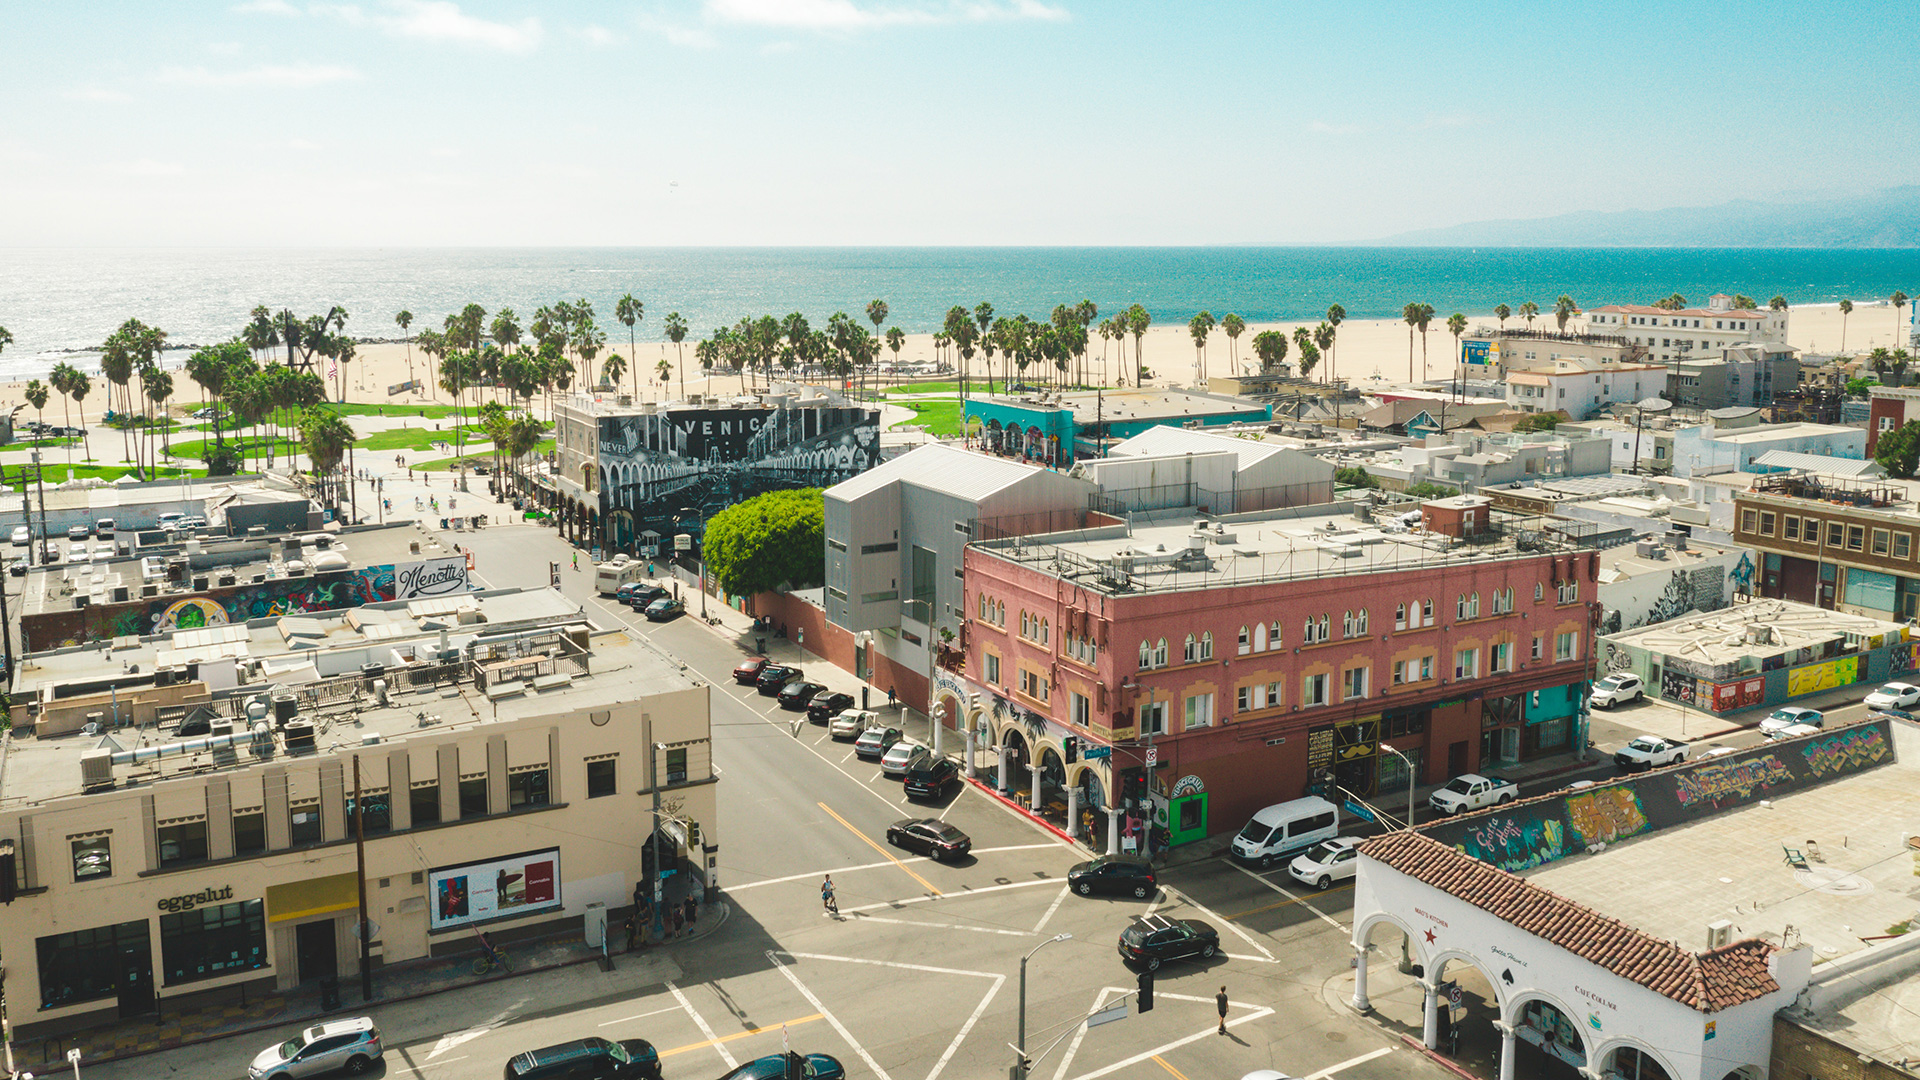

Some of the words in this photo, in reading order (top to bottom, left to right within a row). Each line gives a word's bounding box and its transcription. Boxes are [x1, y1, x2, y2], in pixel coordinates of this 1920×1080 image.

[685, 417, 760, 436] VENIC
[600, 441, 627, 455] NEVER
[529, 877, 550, 885] Cannabis
[157, 884, 234, 912] eggslut
[1429, 915, 1449, 928] KITCHEN
